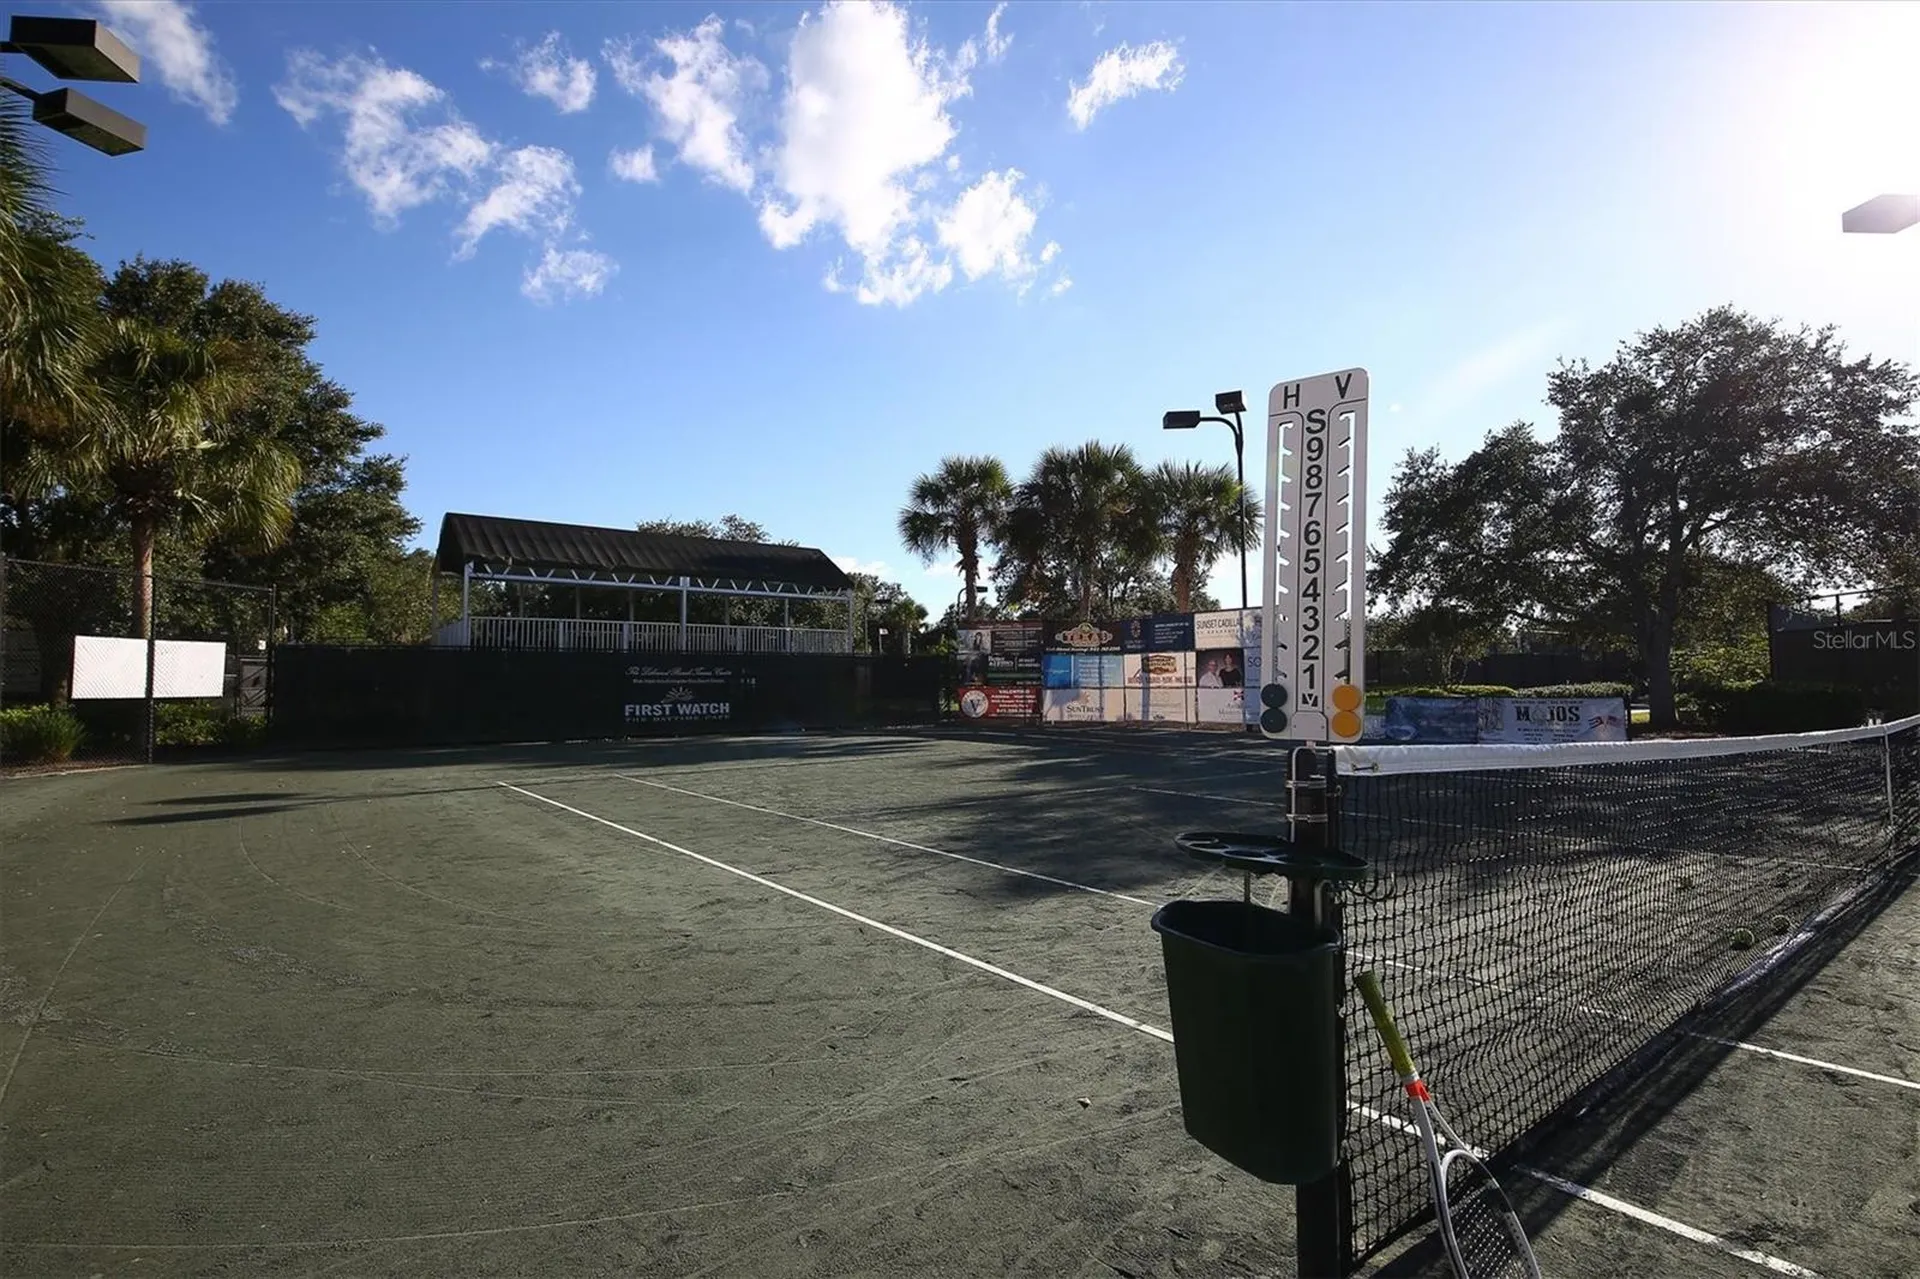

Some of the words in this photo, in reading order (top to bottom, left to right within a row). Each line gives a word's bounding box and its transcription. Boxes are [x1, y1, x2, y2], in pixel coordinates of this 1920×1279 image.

[1282, 383, 1301, 410] H
[1334, 372, 1353, 400] V
[624, 703, 673, 717] FIRST
[676, 702, 730, 716] WATCH
